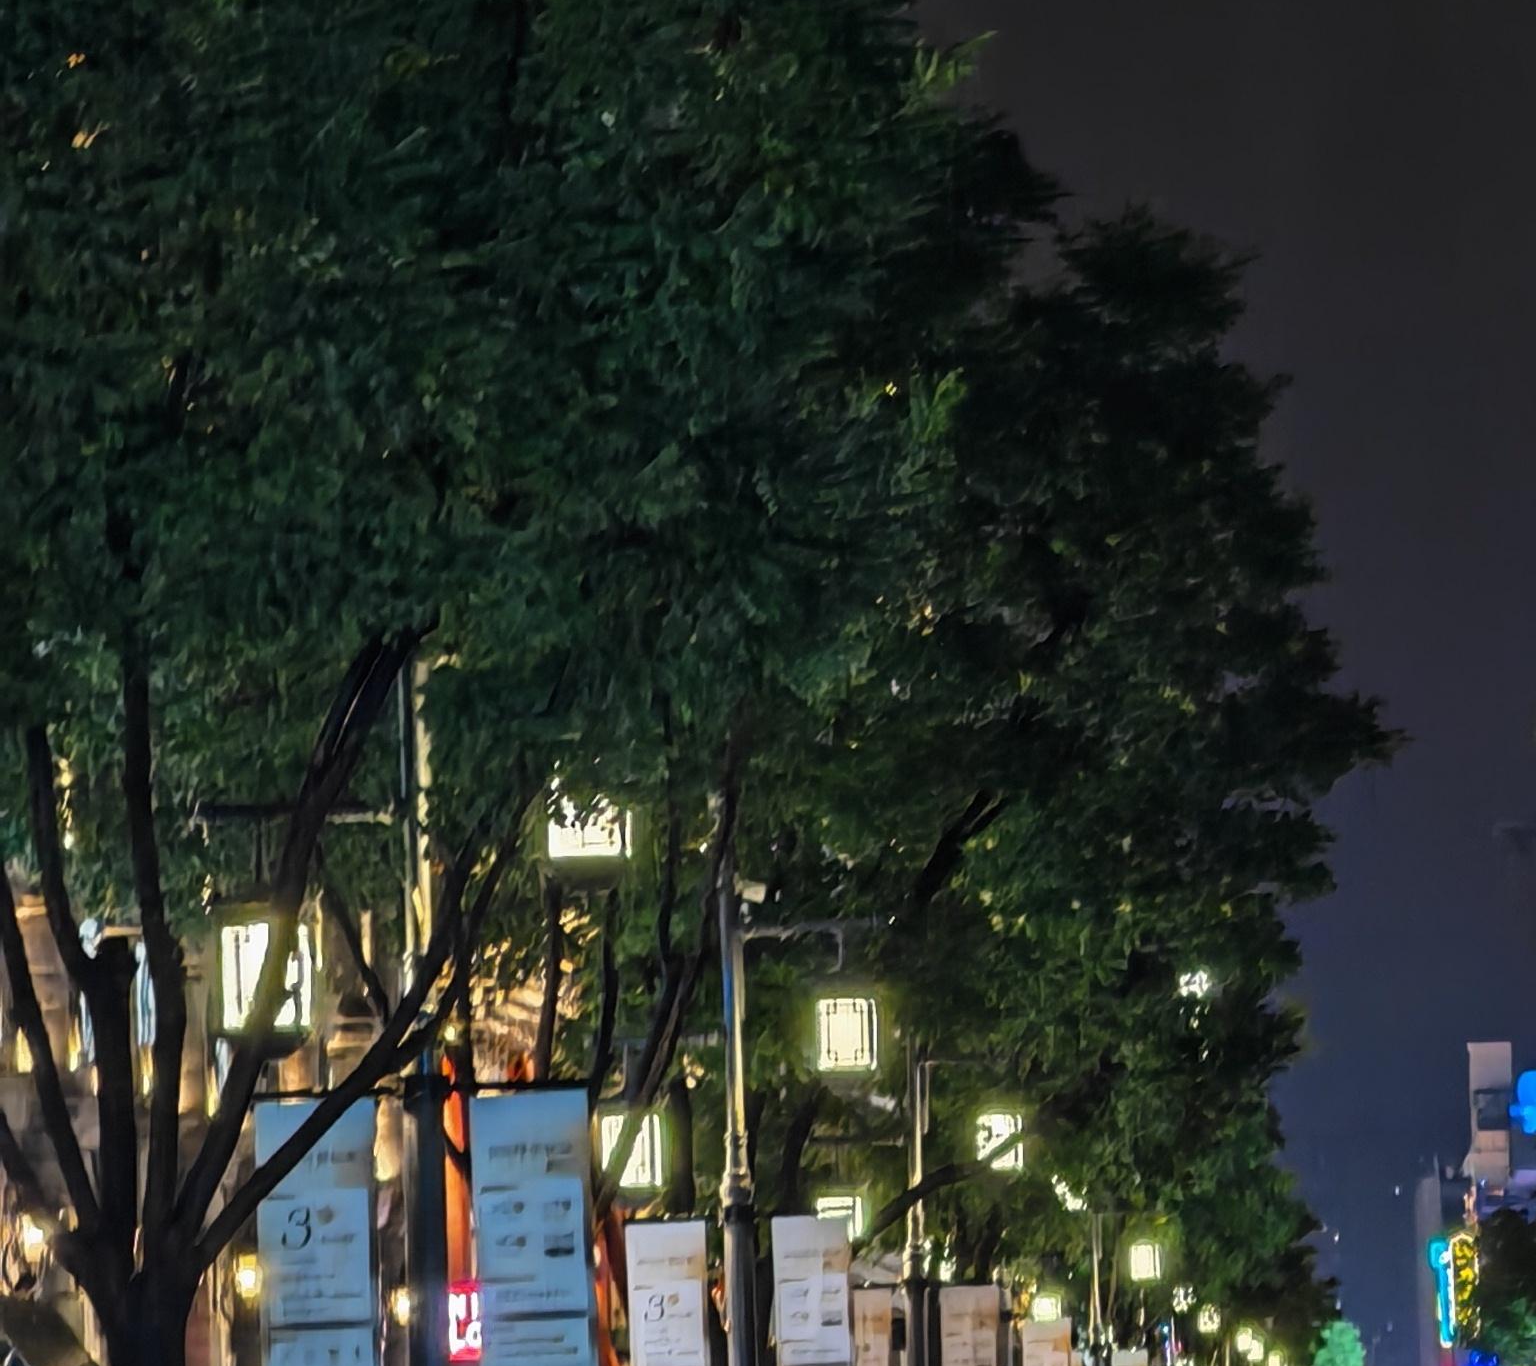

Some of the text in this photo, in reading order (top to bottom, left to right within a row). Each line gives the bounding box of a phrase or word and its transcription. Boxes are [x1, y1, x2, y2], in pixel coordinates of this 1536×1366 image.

[281, 1206, 312, 1249] 3
[448, 1291, 478, 1321] NI
[644, 1292, 665, 1323] 3
[449, 1320, 482, 1355] LO
